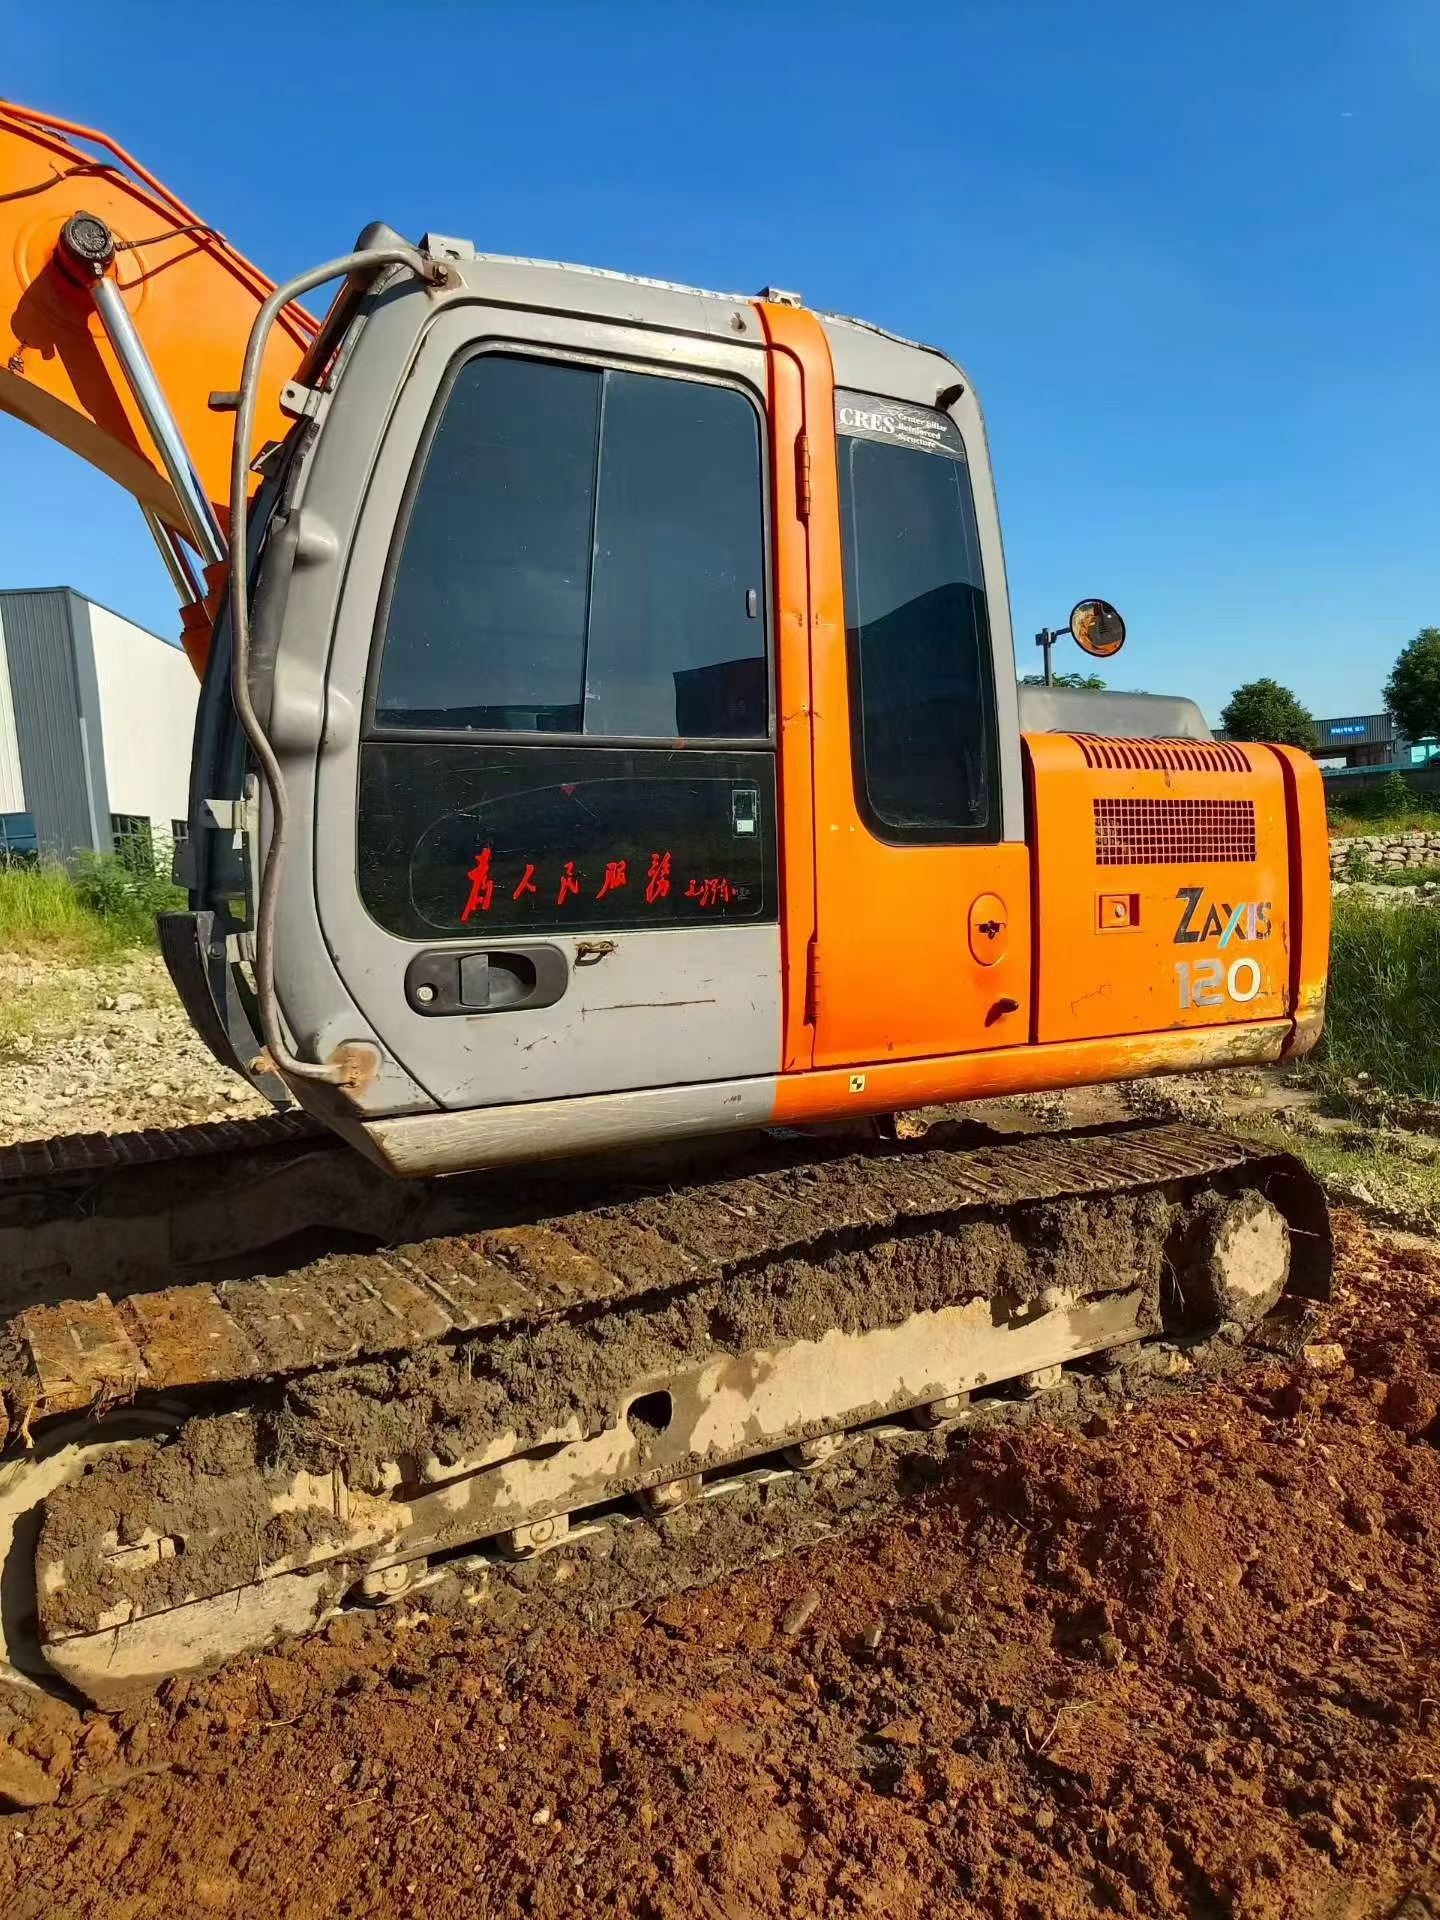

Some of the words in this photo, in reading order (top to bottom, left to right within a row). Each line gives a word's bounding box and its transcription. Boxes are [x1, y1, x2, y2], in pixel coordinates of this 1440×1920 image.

[840, 407, 895, 434] CRES
[897, 413, 925, 425] Center
[1175, 958, 1261, 1008] 120
